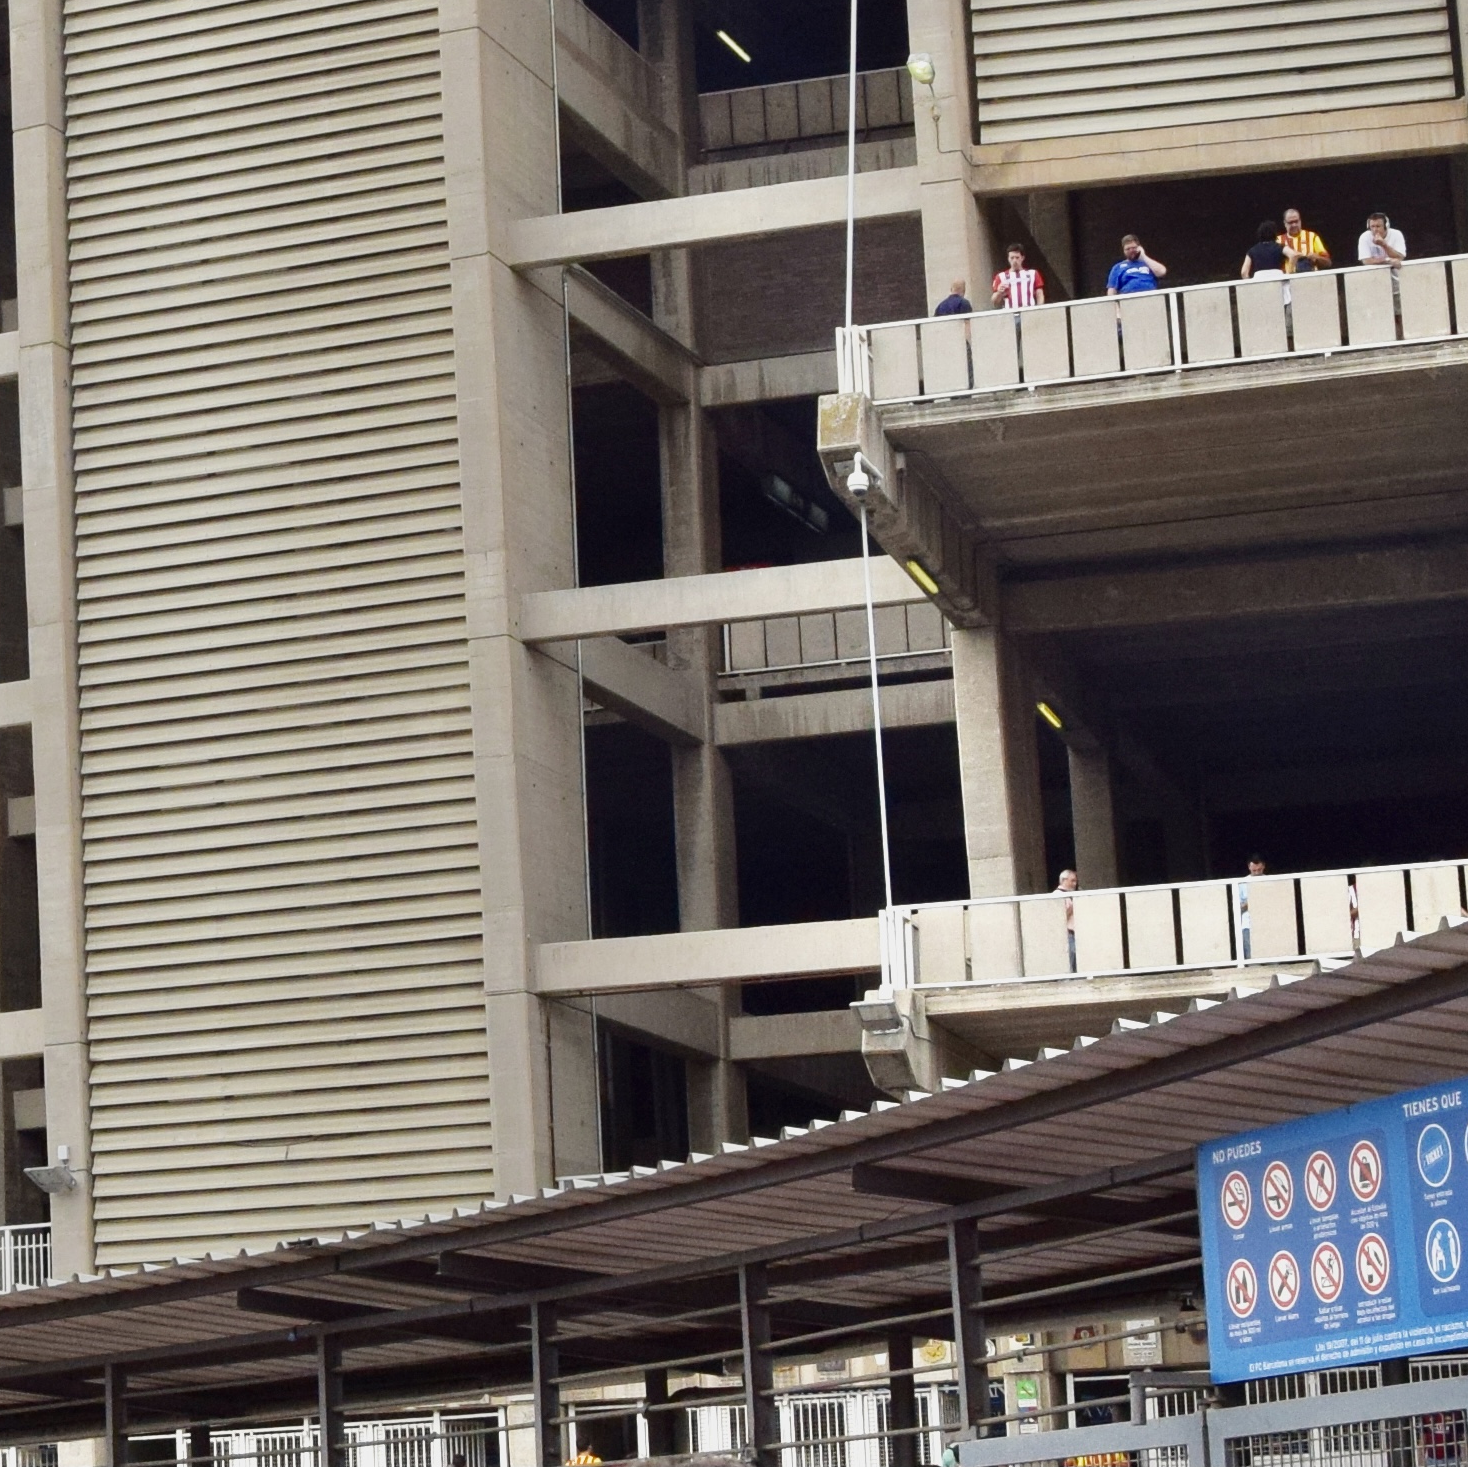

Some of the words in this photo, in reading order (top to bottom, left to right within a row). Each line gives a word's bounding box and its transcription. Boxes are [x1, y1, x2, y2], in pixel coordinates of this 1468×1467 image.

[1402, 1098, 1439, 1118] TIENES
[1441, 1091, 1462, 1109] QUE
[1213, 1149, 1225, 1164] NO
[1227, 1141, 1262, 1161] PUEDES
